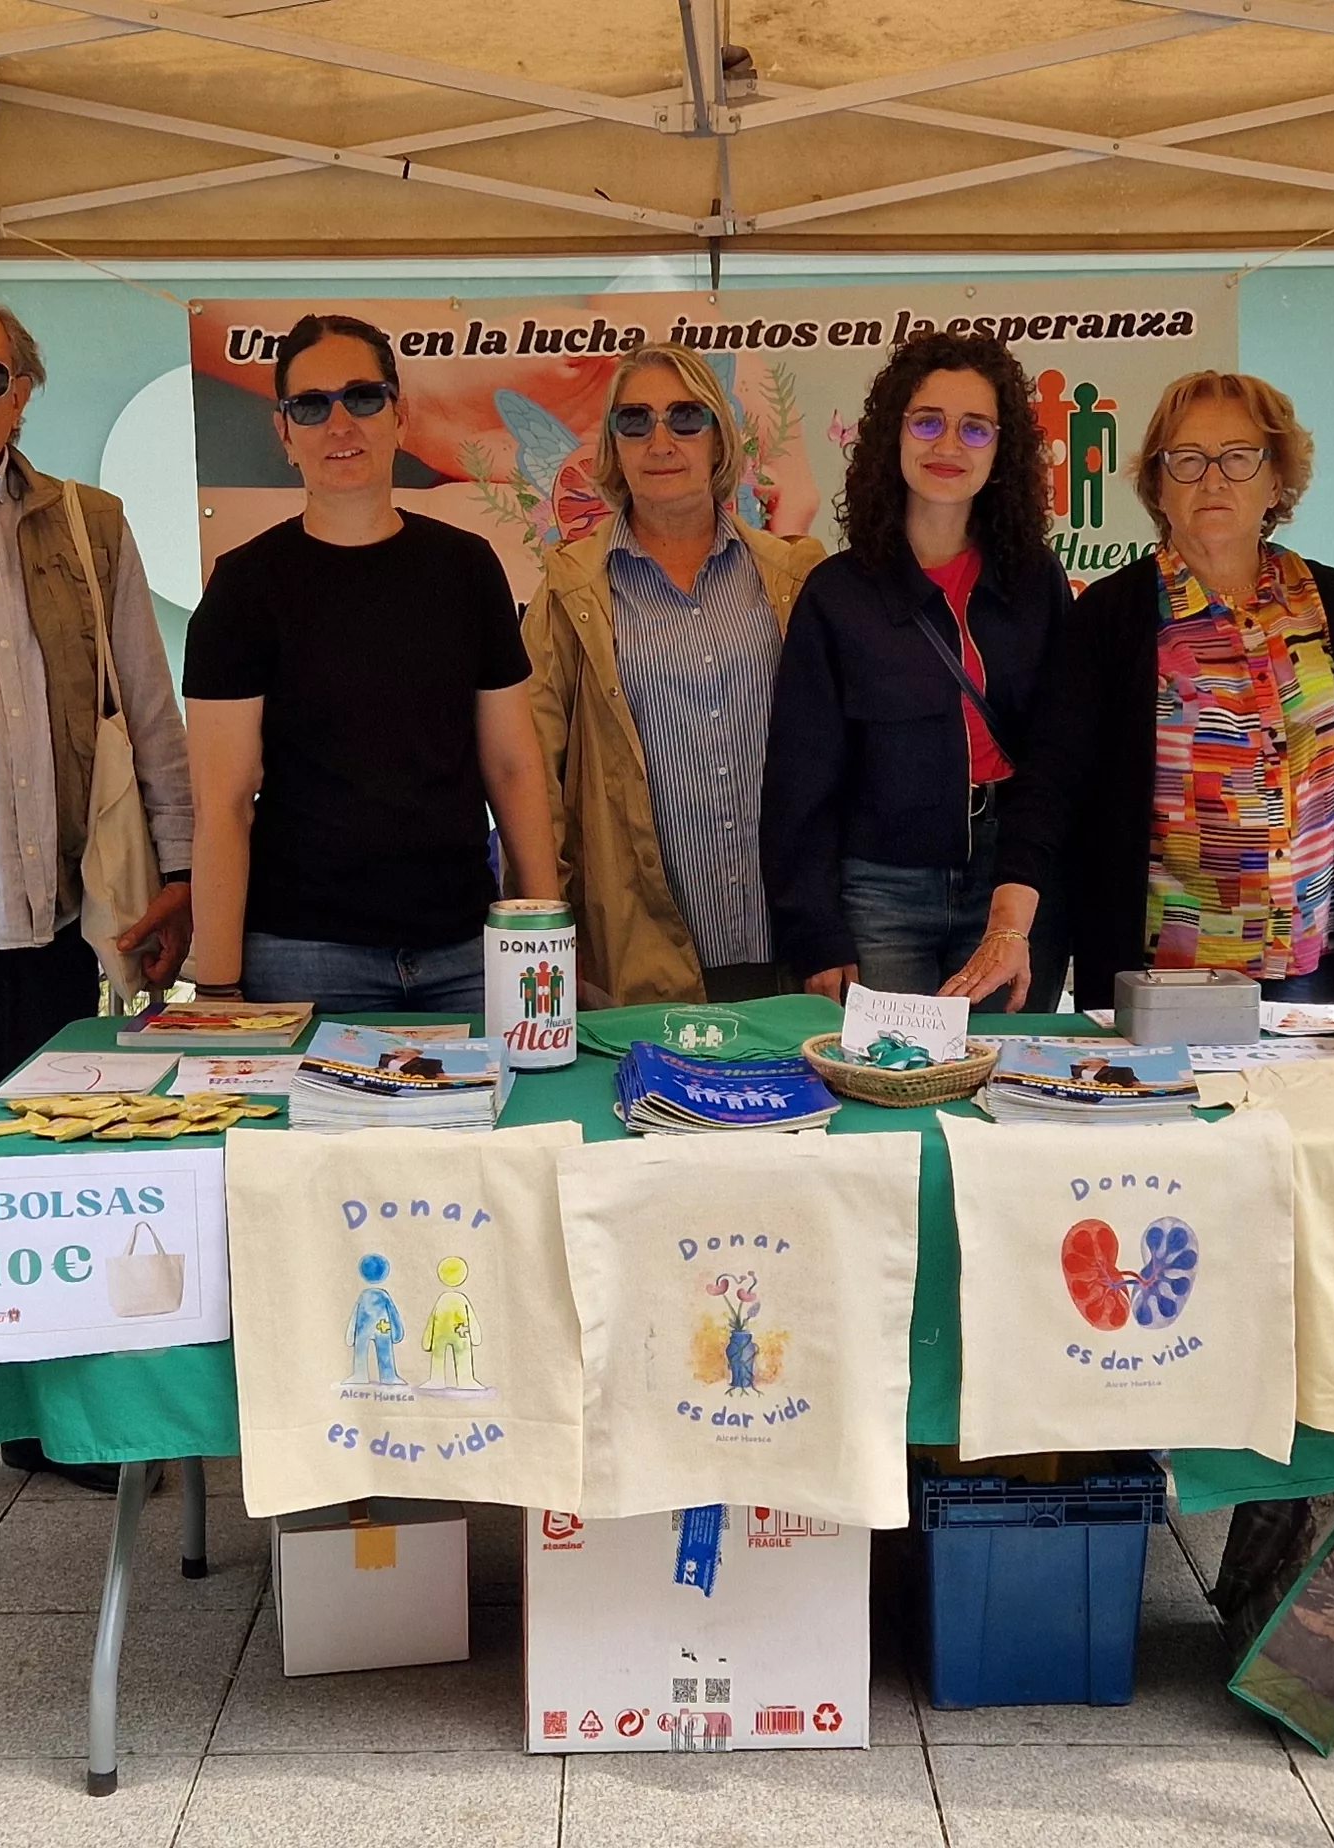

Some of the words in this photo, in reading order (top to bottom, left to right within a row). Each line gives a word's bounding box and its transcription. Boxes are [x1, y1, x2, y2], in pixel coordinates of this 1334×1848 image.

[400, 328, 455, 358] en
[466, 320, 509, 356] la
[668, 317, 819, 351] juntos
[828, 318, 883, 347] en
[894, 311, 936, 345] la
[947, 309, 1195, 343] esperanza
[1051, 532, 1159, 571] Huesc
[864, 1011, 947, 1031] SOLIDARIA
[872, 998, 943, 1018] PULSERA
[503, 1020, 573, 1052] Alcer
[1070, 1173, 1184, 1202] Donar
[342, 1198, 492, 1230] Donar
[678, 1232, 791, 1262] Donar
[1066, 1341, 1094, 1366] es
[1101, 1347, 1144, 1373] dar
[1152, 1333, 1204, 1367] vida
[340, 1389, 371, 1399] Alcer
[374, 1392, 415, 1402] Huesca
[675, 1398, 704, 1424] es
[712, 1406, 755, 1429] dar
[762, 1396, 812, 1426] vida
[327, 1419, 360, 1448] es
[370, 1430, 427, 1463] dar
[436, 1420, 505, 1460] vida
[716, 1434, 739, 1443] Alcer
[741, 1434, 772, 1443] Huesca
[748, 1538, 792, 1548] FRAGILE
